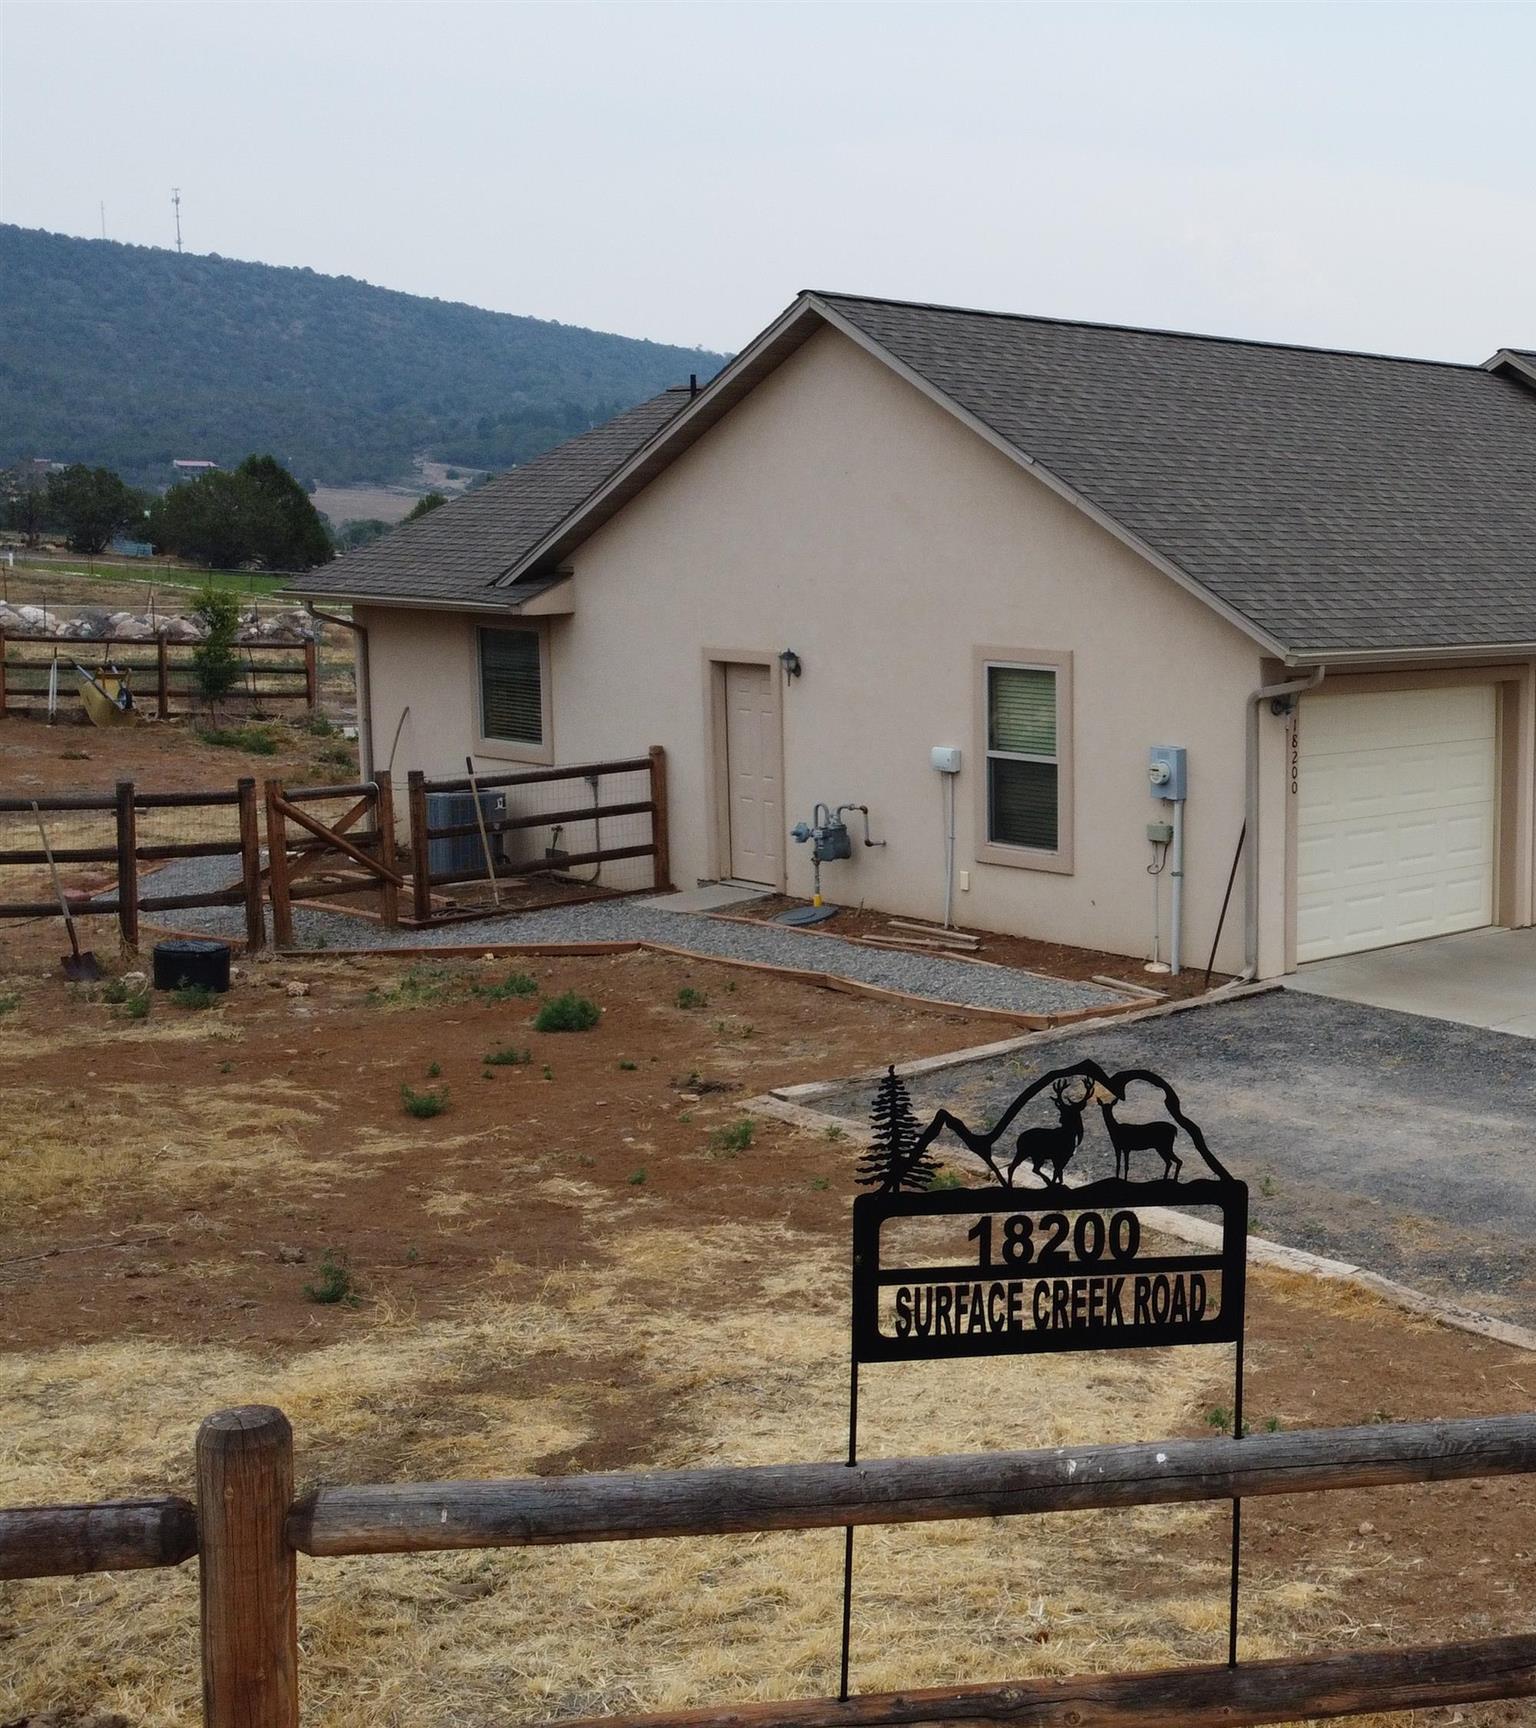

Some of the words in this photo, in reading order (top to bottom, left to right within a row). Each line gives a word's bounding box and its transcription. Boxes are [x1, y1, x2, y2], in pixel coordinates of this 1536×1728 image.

[967, 1211, 1140, 1269] 18200
[895, 1282, 1023, 1338] SURFACE
[1032, 1277, 1125, 1332] CREEK
[1133, 1273, 1206, 1326] ROAD
